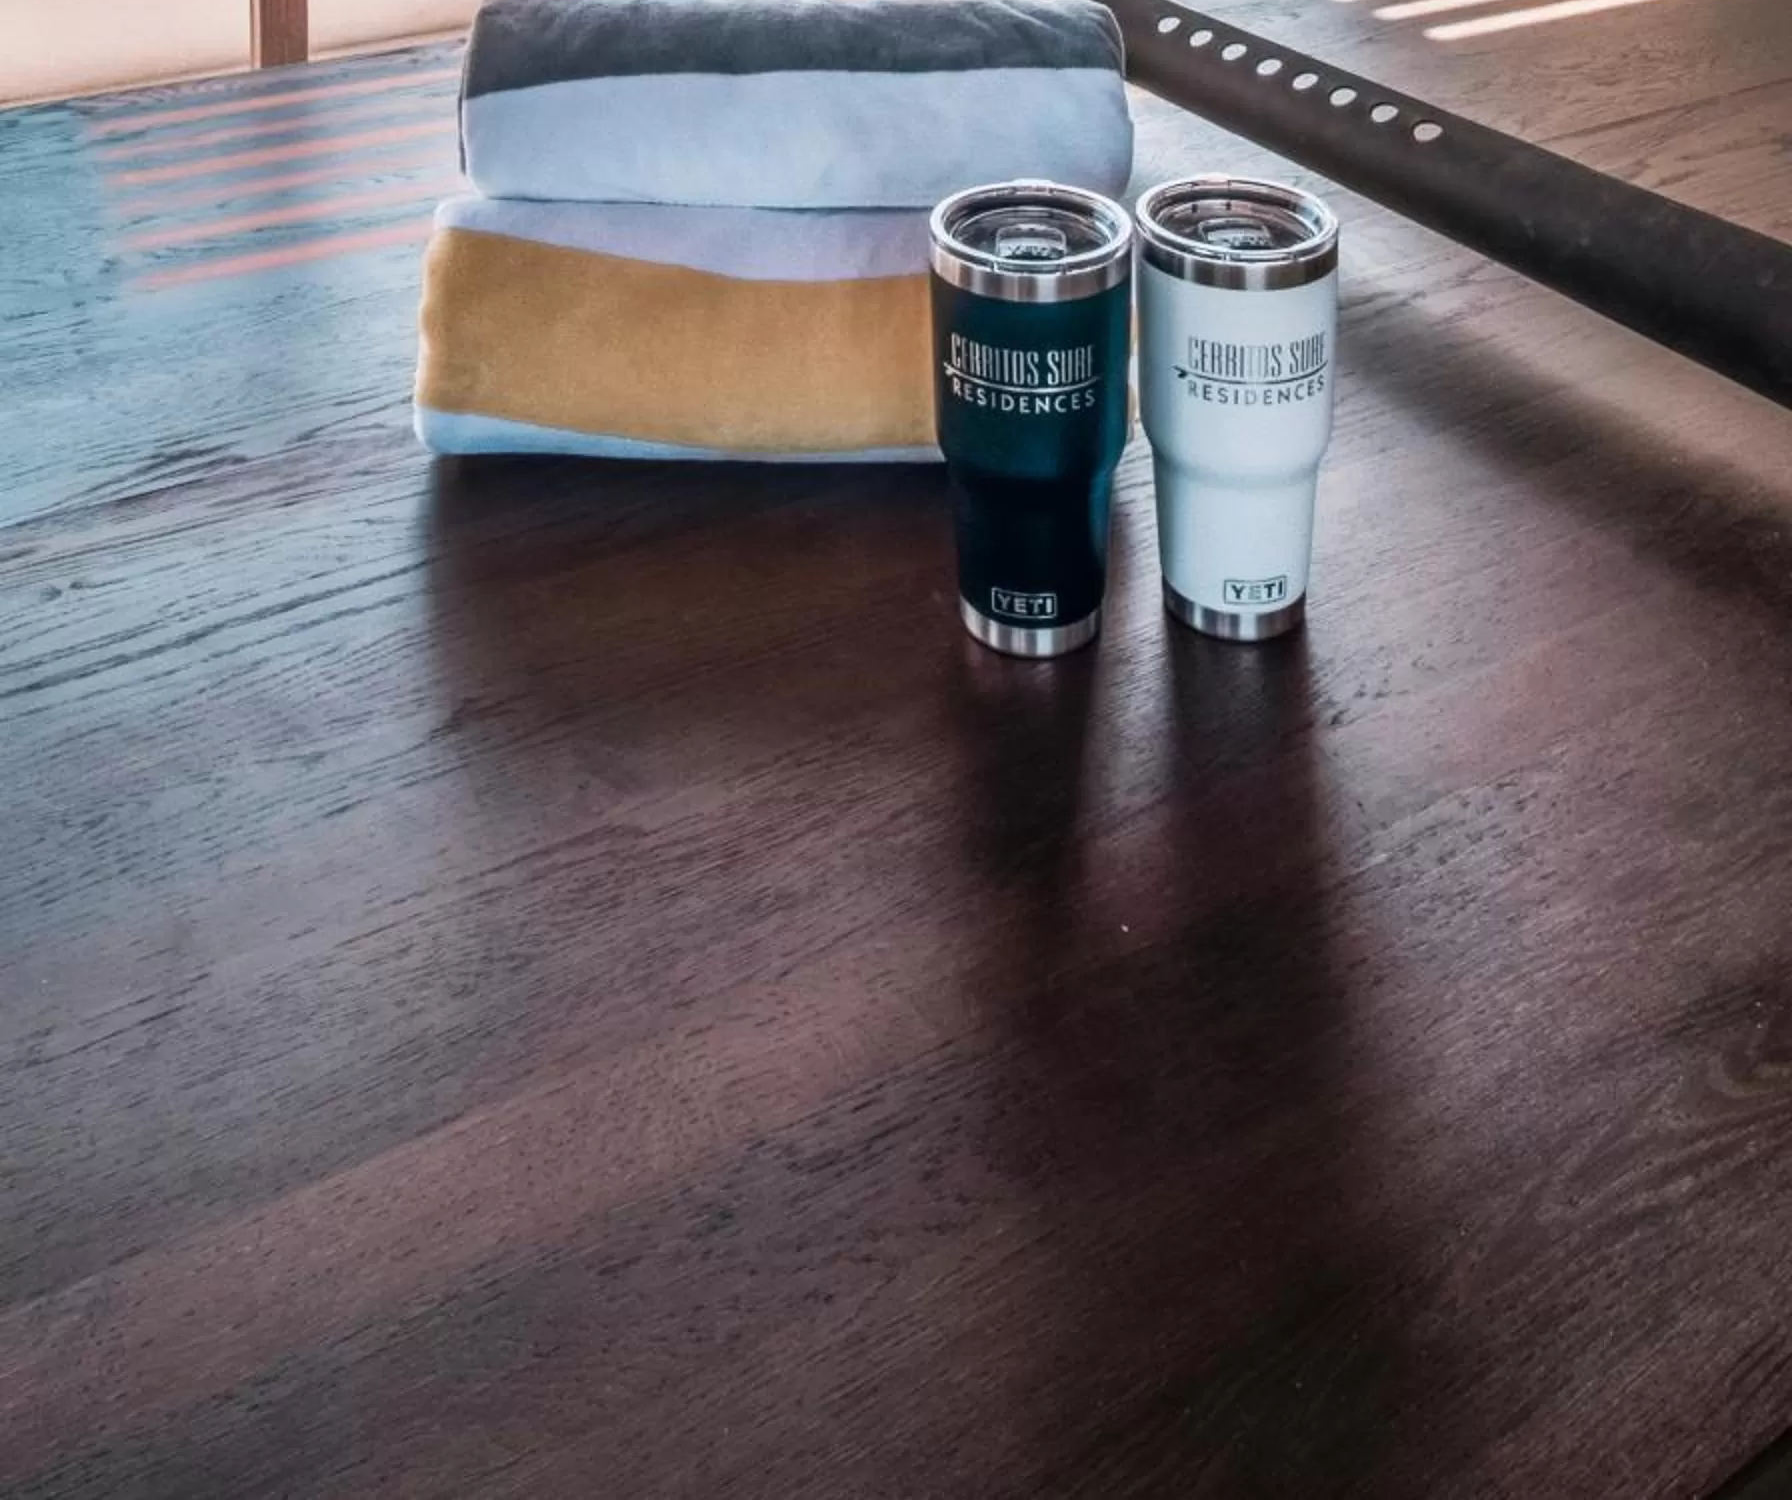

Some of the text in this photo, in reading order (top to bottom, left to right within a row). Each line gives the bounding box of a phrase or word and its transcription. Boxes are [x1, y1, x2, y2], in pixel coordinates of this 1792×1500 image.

[951, 332, 1095, 386] CERRITOS SURF
[1188, 331, 1327, 379] CERRITOS SURF
[952, 377, 1095, 414] RESIDENCES
[1187, 375, 1325, 405] RESIDENCES
[997, 592, 1054, 616] YETI
[1230, 581, 1285, 600] YETI
